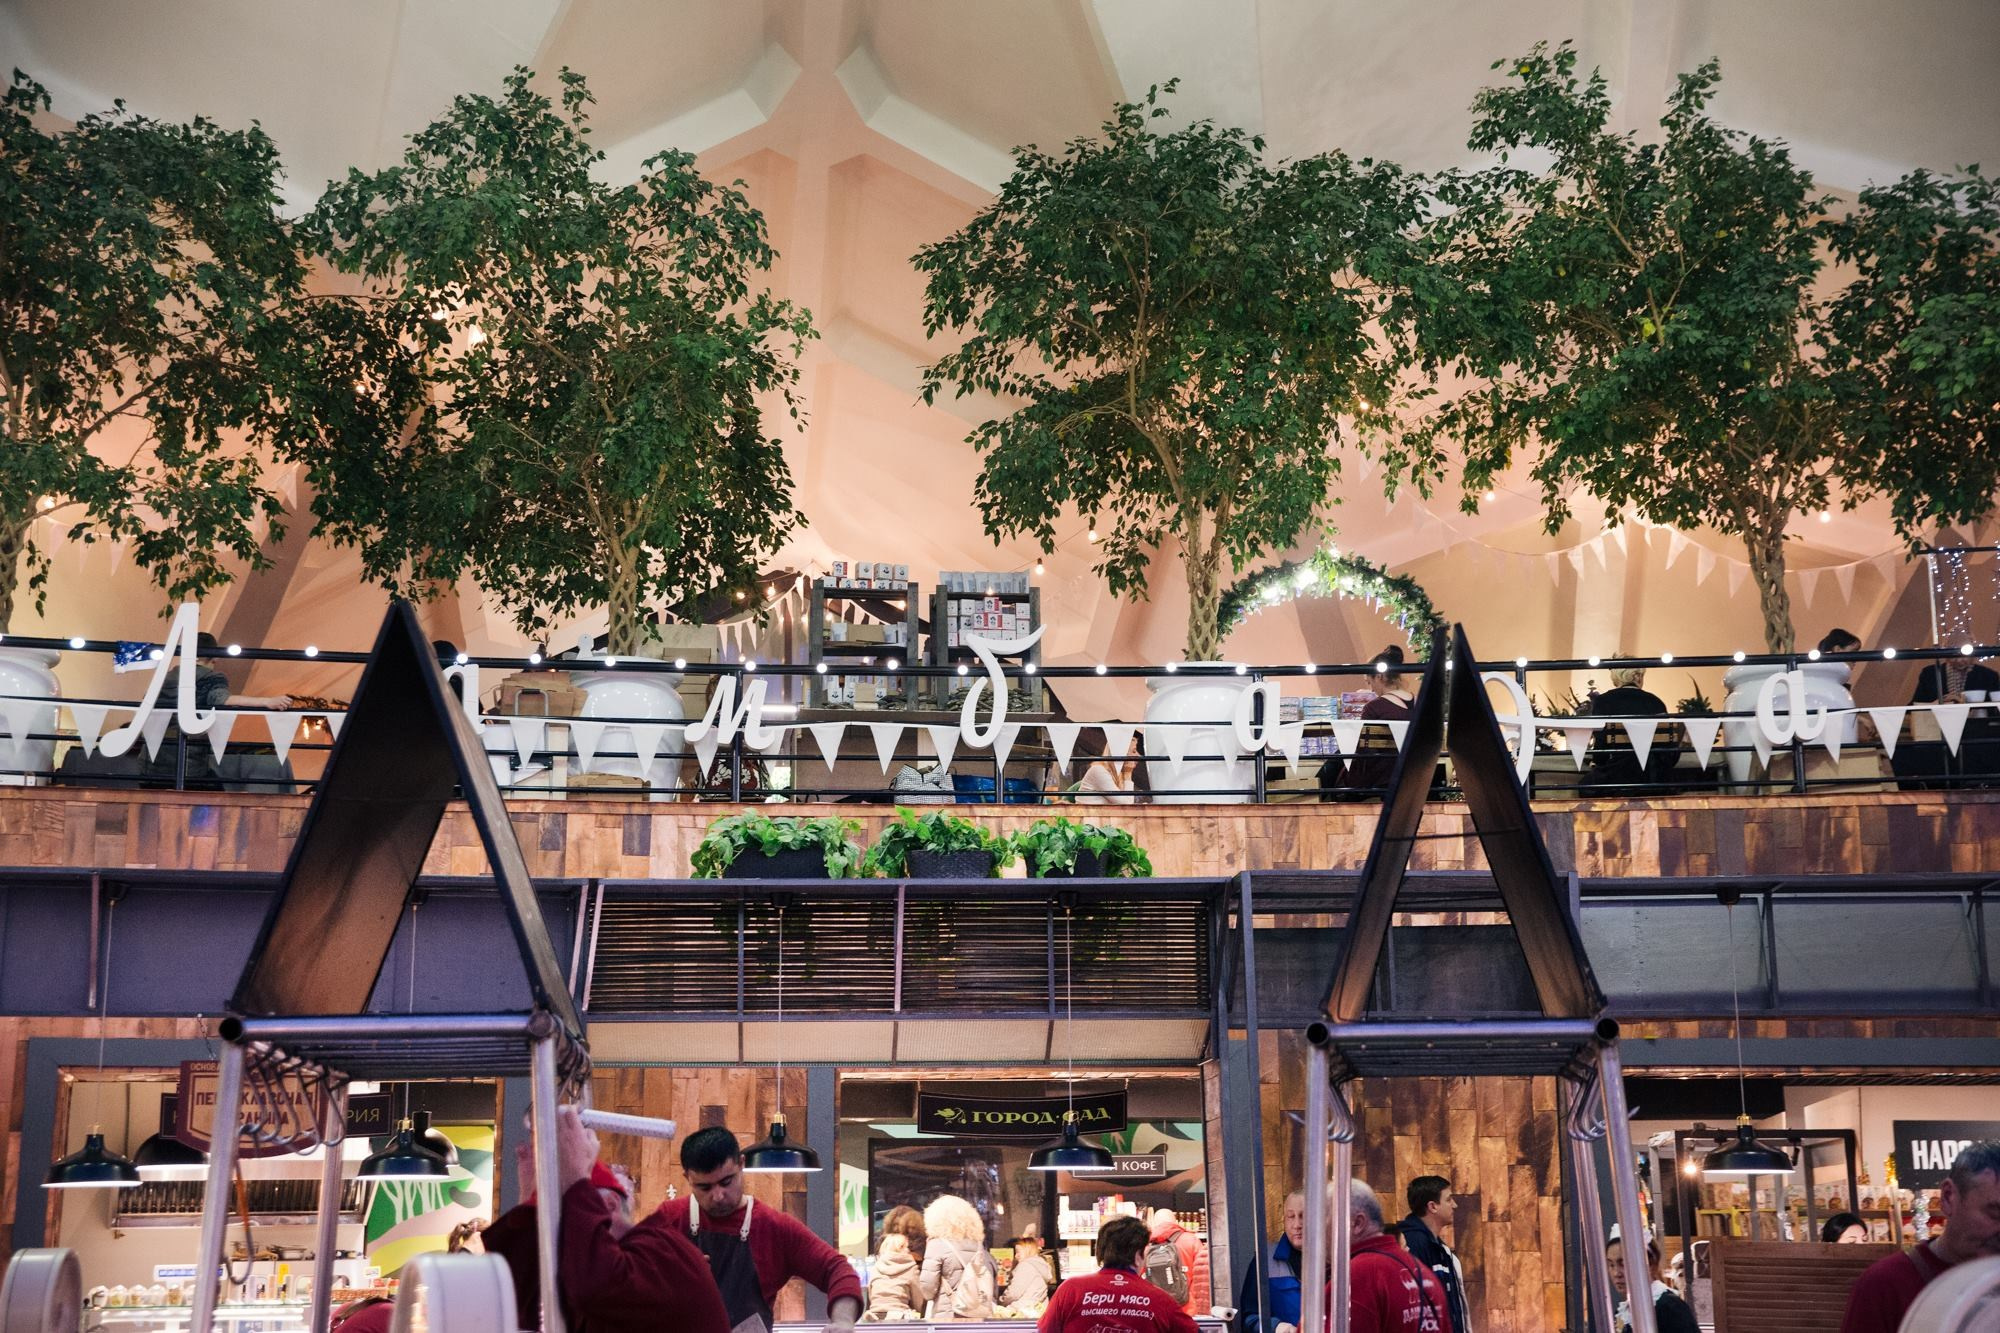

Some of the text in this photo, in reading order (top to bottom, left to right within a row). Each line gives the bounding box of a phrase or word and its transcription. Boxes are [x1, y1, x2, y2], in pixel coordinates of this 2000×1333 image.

[1122, 1160, 1157, 1171] КОФЕ
[1082, 1291, 1151, 1306] Бери мясо
[1080, 1308, 1119, 1316] высшего
